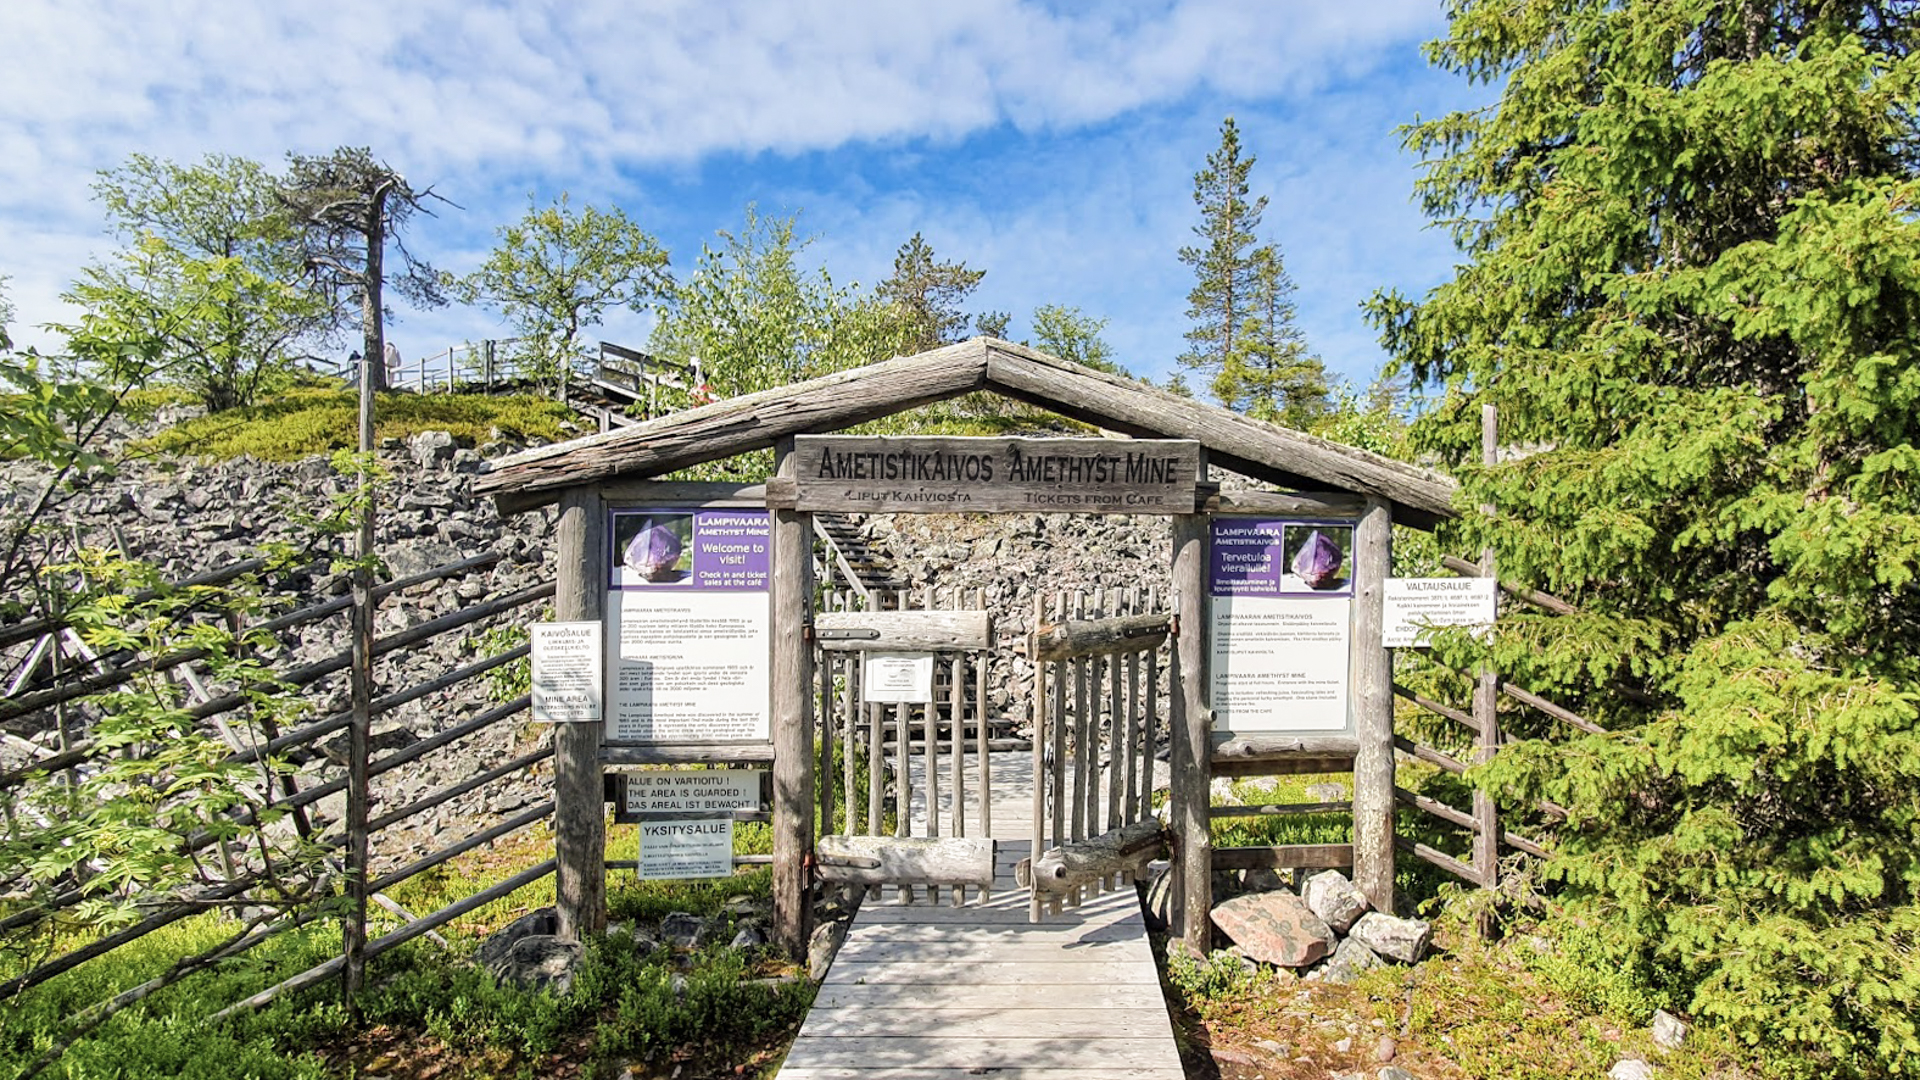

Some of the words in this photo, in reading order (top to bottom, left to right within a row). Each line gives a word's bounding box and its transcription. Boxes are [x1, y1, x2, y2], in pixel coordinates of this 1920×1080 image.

[819, 446, 993, 481] AMETISTIKAIVOS
[1009, 449, 1121, 483] AMETHYST
[1125, 452, 1179, 484] MINE
[849, 491, 889, 501] LIPUT
[892, 491, 972, 502] KAHVIOSTA
[1025, 493, 1081, 504] TICKETS
[1085, 495, 1122, 504] FROM
[698, 517, 769, 526] LAMPIVAARA
[698, 528, 745, 536] AMETHYST
[746, 528, 770, 536] MINE
[1216, 528, 1280, 536] LAMPIVAARA
[702, 543, 750, 553] Welcome
[753, 544, 764, 553] to
[720, 555, 745, 564] visit!
[1221, 552, 1272, 562] Tervetuloa
[1406, 582, 1472, 591] VALTAUSALUE
[566, 694, 588, 702] AREA
[675, 777, 723, 785] VARTIOITU
[628, 790, 646, 798] THE
[694, 789, 739, 797] GUARDED
[705, 800, 750, 808] BEWACHT
[644, 824, 726, 836] YKSITYSALUE
